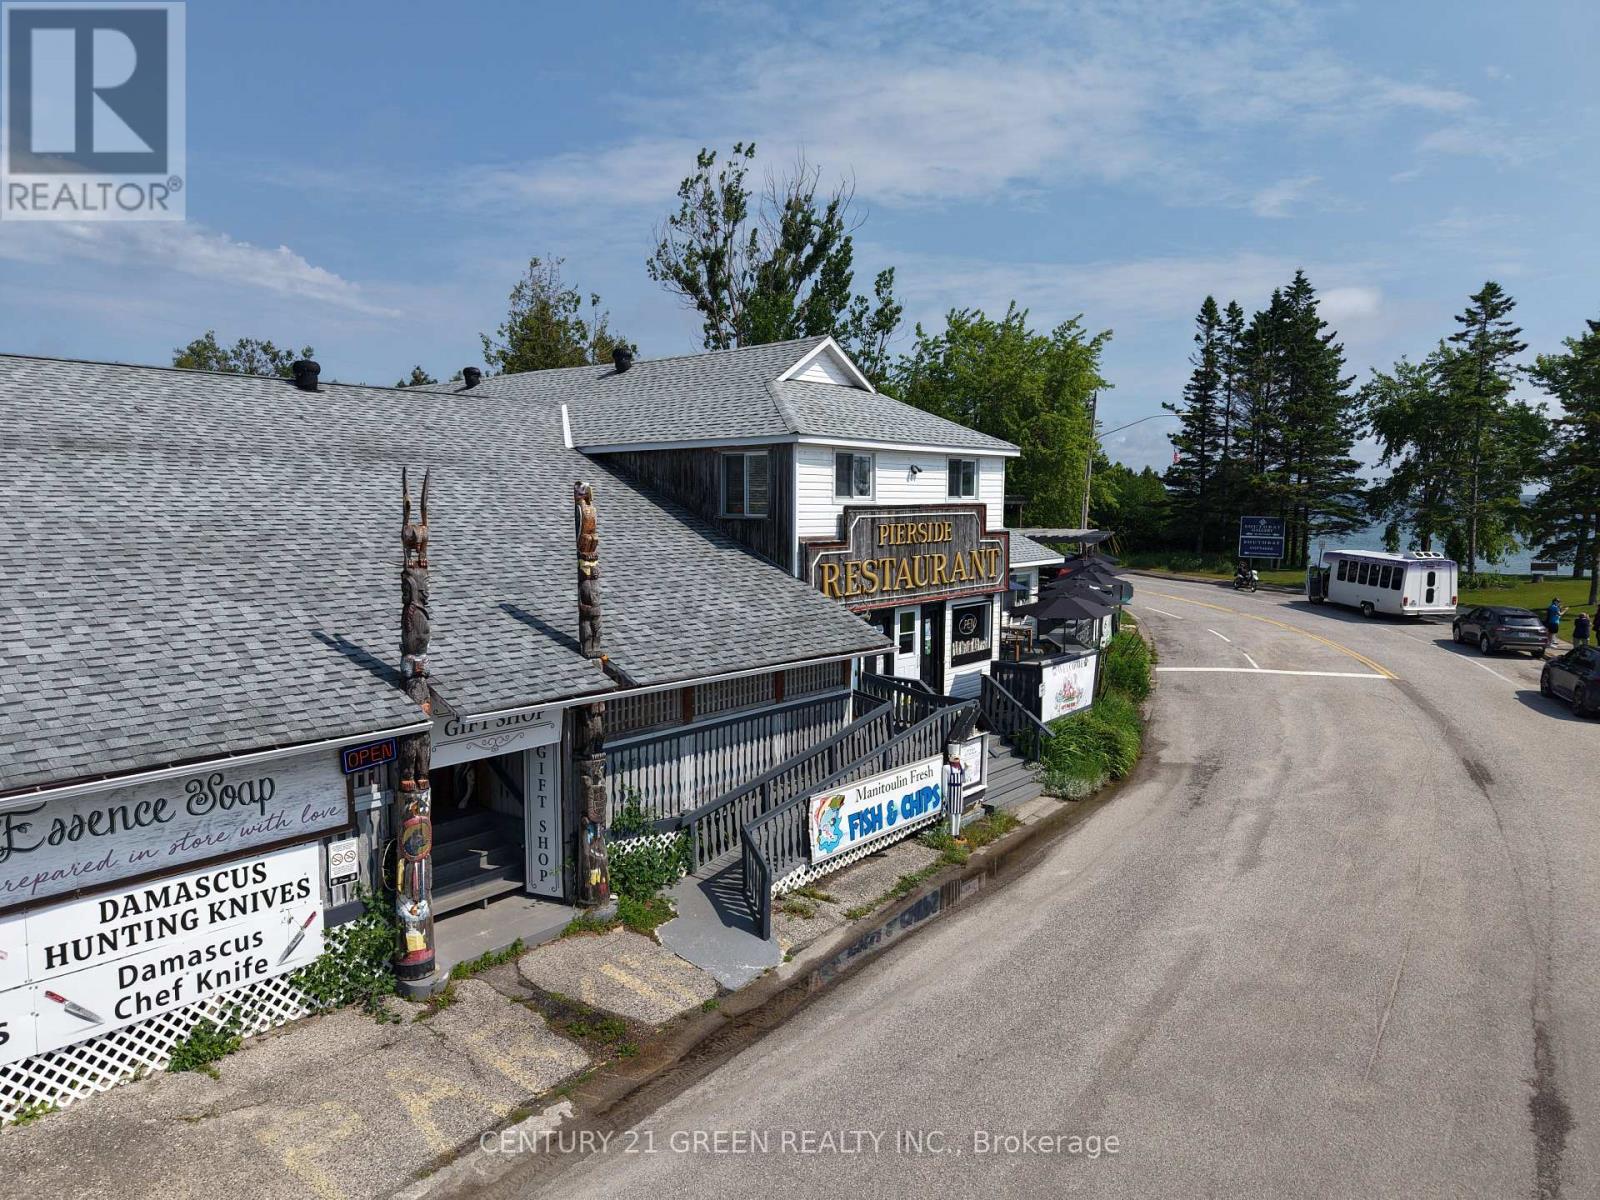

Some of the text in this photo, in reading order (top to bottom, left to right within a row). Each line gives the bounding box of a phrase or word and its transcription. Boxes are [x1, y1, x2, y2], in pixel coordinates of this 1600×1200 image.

[878, 522, 953, 546] PIERSIDE
[820, 548, 999, 598] RESTAURANT
[348, 743, 393, 768] OPEN
[855, 765, 934, 802] Manitoulin Fresh
[185, 773, 276, 816] Soap
[536, 745, 549, 882] GIFT SHOP
[848, 783, 941, 841] FISH & CHIPS
[128, 848, 159, 863] in
[168, 831, 230, 855] store
[240, 810, 293, 837] with
[301, 803, 344, 824] love
[99, 862, 267, 924] DAMASCUS
[44, 877, 311, 969] HUNTING KNIVES
[114, 958, 269, 1020] Chef Knife
[118, 930, 264, 990] Damascus
